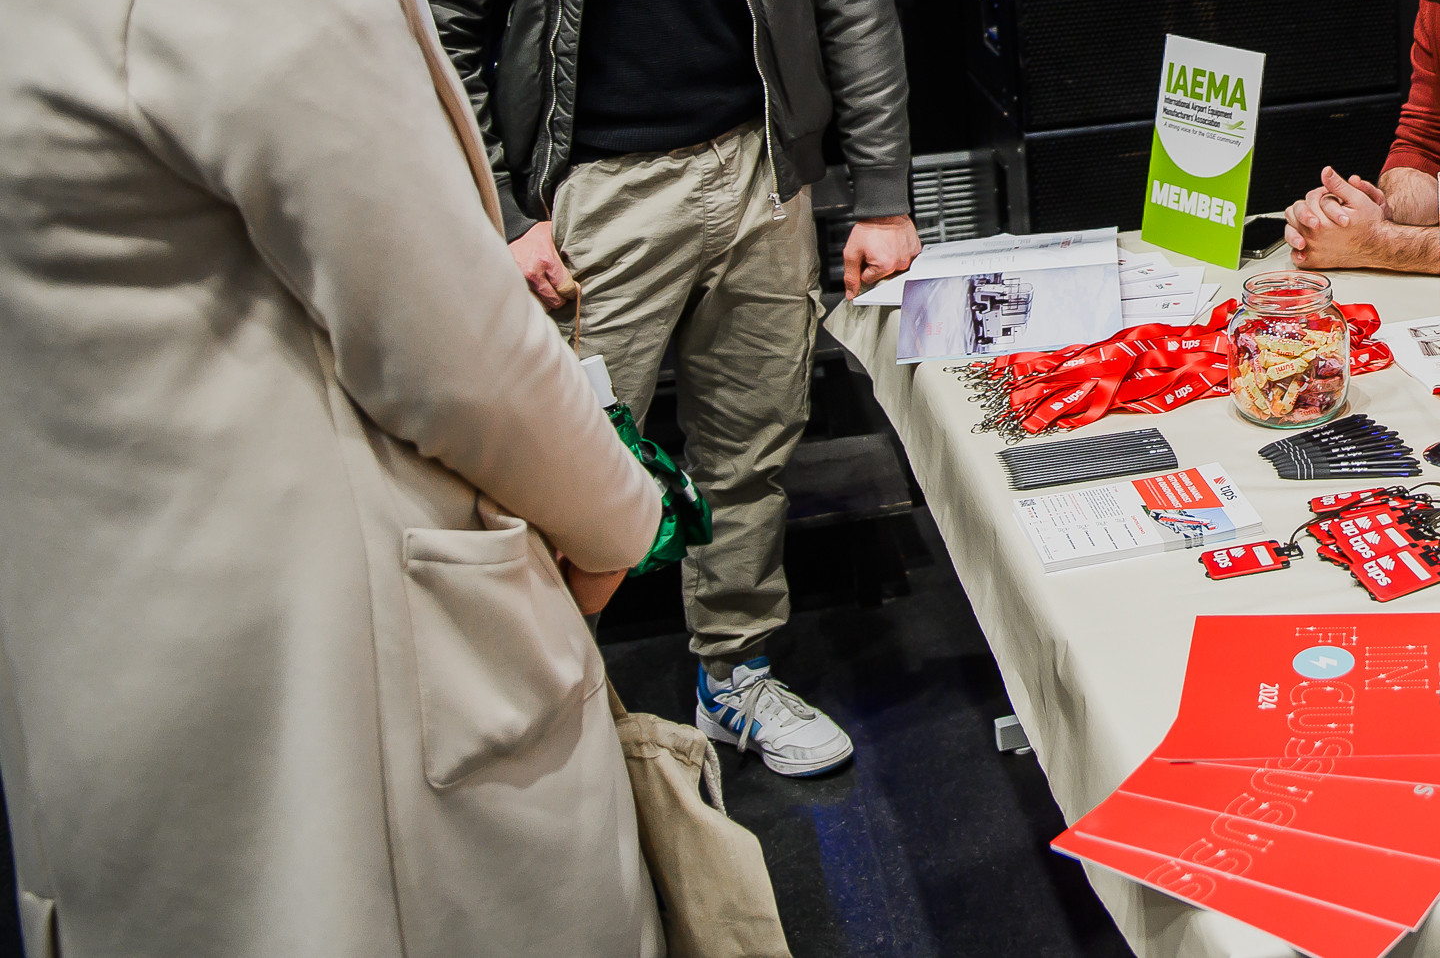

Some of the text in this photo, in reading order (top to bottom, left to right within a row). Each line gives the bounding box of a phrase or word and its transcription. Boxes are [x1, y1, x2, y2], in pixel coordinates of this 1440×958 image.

[1165, 62, 1248, 112] IAEMA
[1164, 95, 1233, 119] International Airport Equipment
[1194, 114, 1221, 128] Association
[1217, 136, 1242, 147] community
[1151, 180, 1238, 228] MEMBER
[1182, 339, 1200, 349] tips
[1062, 389, 1085, 404] tips
[1175, 383, 1193, 399] tips
[1220, 485, 1238, 501] tips
[1340, 520, 1360, 537] tip
[1349, 535, 1376, 559] tips
[1212, 550, 1233, 569] tips
[1363, 560, 1392, 587] tips
[1258, 682, 1280, 710] 2024
